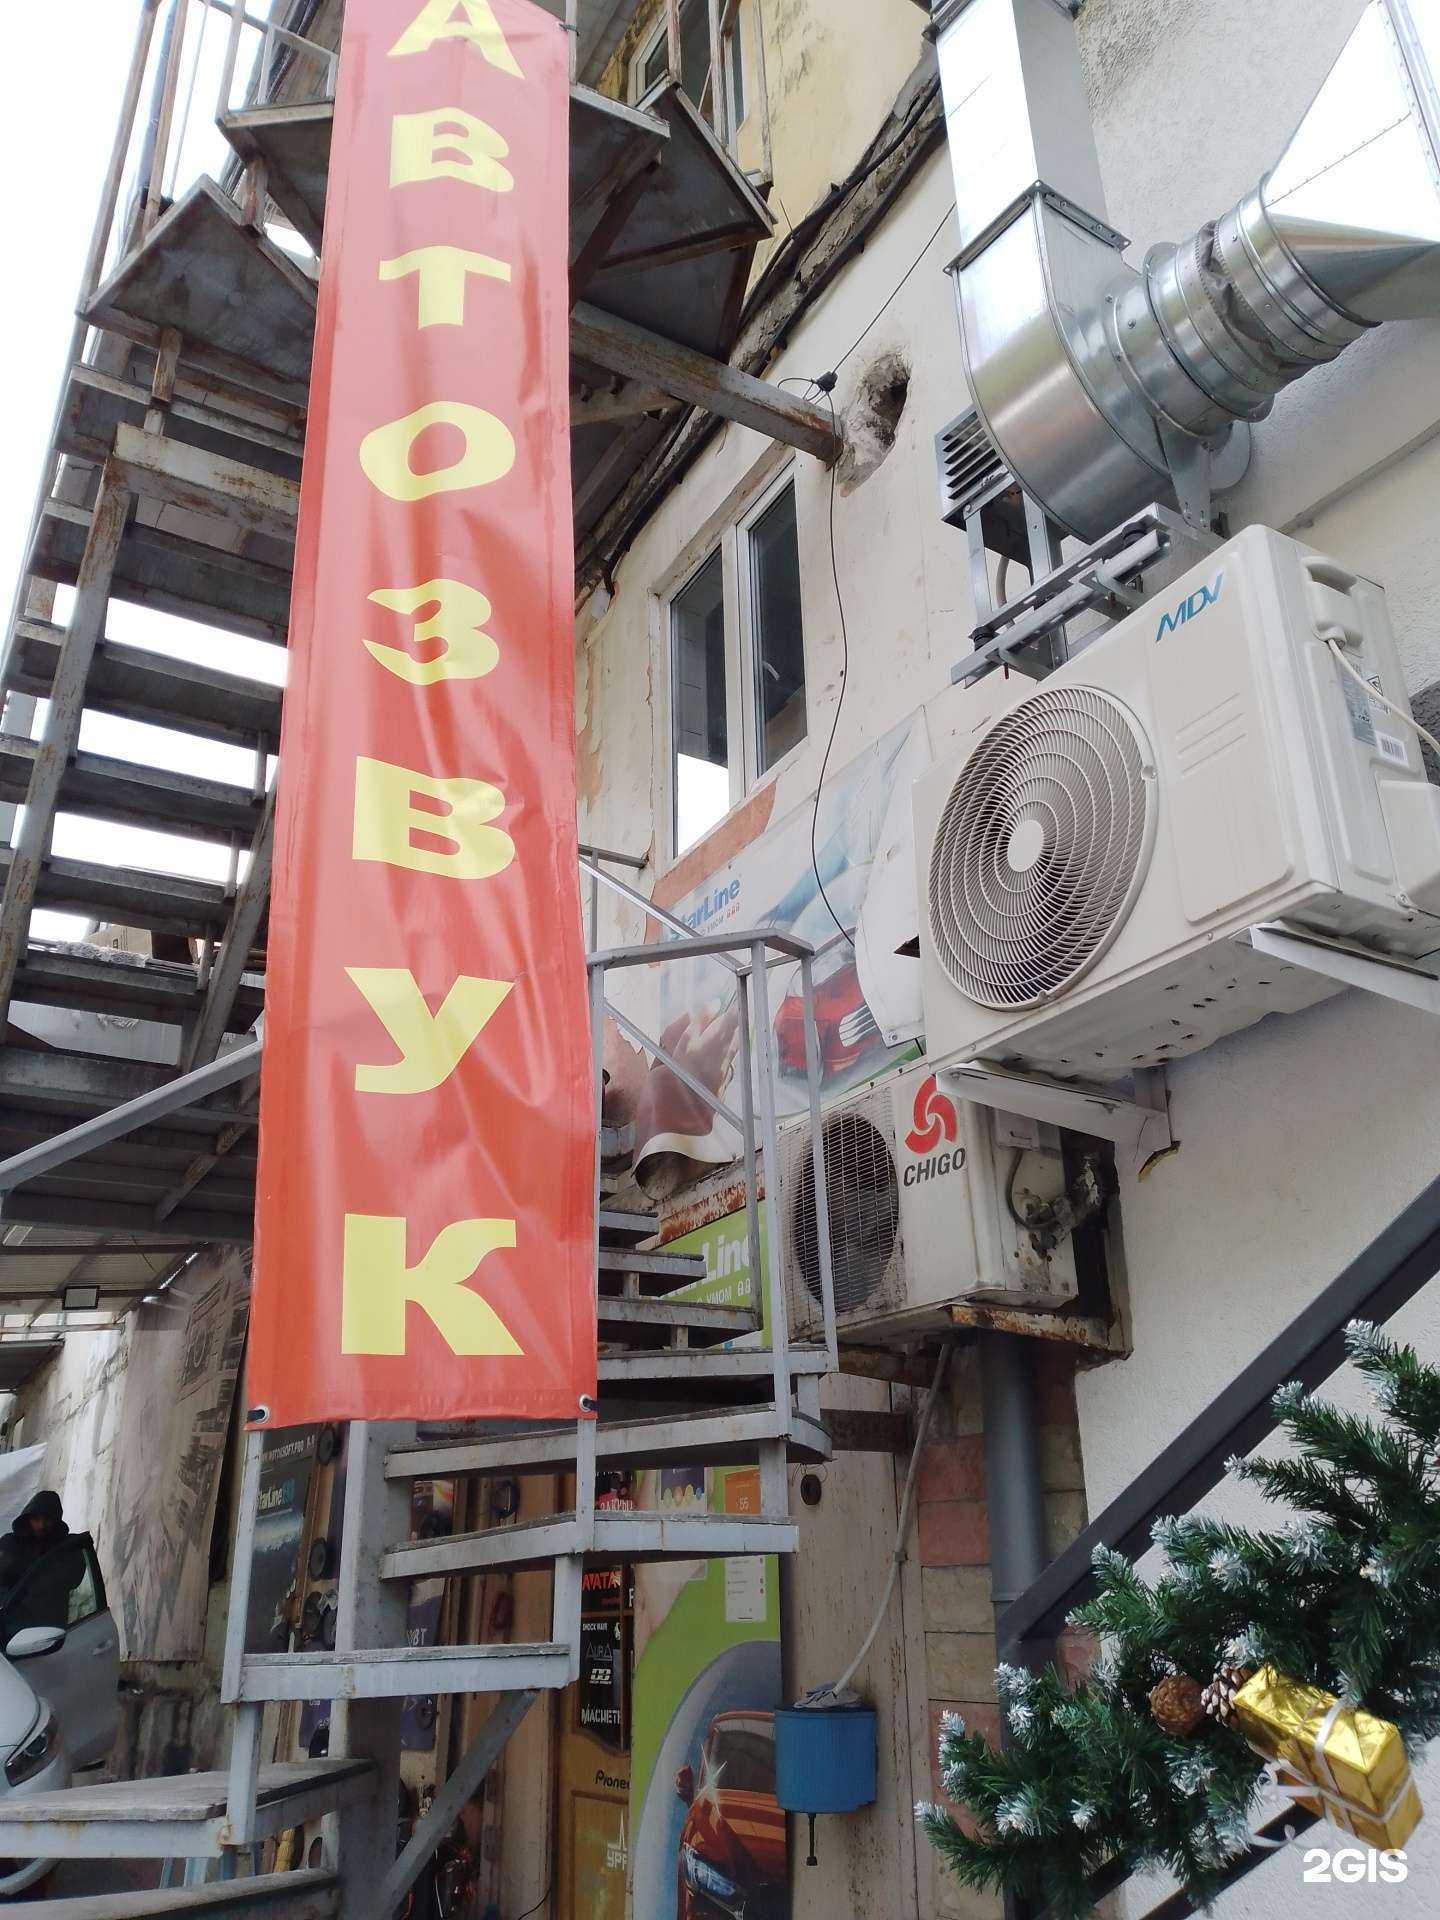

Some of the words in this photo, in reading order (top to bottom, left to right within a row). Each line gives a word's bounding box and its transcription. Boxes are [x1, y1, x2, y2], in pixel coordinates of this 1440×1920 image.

[1156, 572, 1223, 643] MDV
[341, 0, 527, 1356] АВТОЗВУК
[903, 1147, 967, 1188] CHIGO
